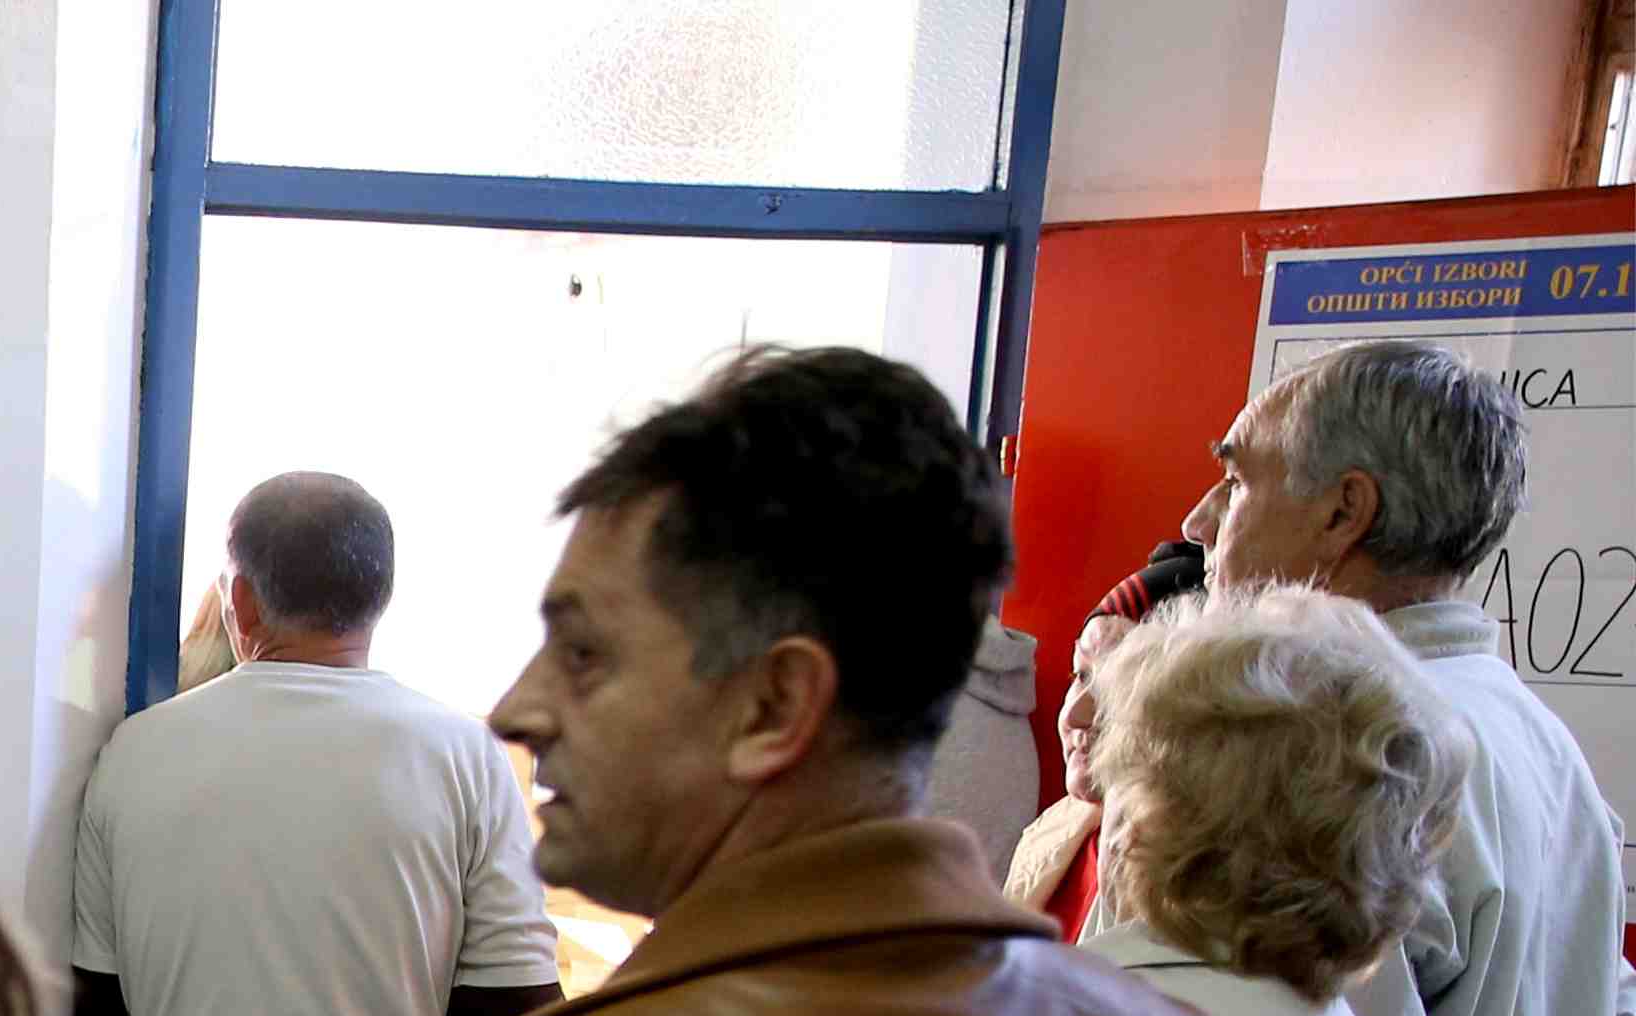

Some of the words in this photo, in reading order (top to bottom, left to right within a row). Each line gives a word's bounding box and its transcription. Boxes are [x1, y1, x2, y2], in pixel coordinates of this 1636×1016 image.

[1360, 260, 1422, 285] OPĆI
[1433, 259, 1529, 284] IZBORI
[1549, 263, 1631, 300] 07.1
[1307, 291, 1409, 314] ОПШТИ
[1415, 286, 1524, 310] ИЗБОРИ
[1500, 368, 1577, 409] ICA
